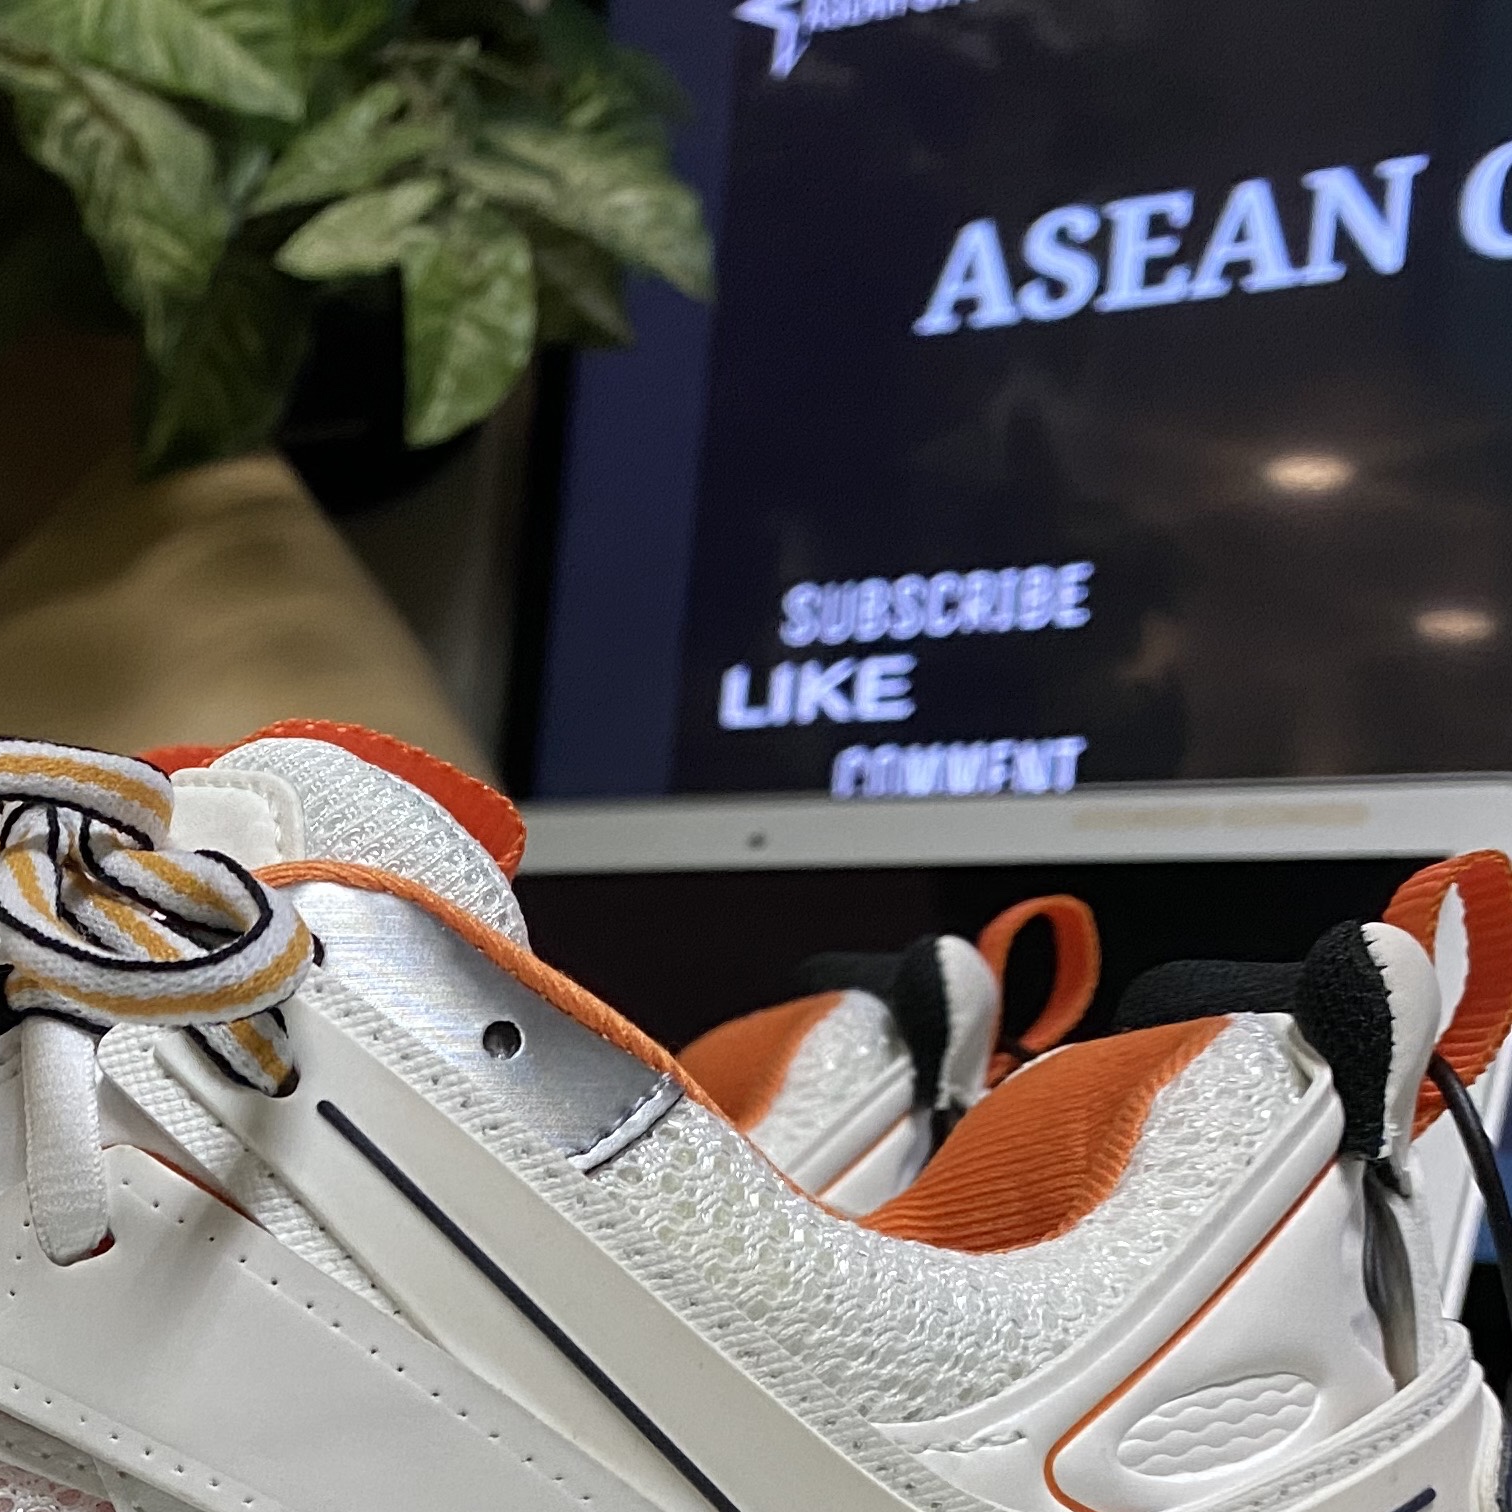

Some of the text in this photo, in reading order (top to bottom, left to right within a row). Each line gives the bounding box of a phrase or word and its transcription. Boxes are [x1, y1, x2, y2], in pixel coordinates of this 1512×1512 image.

[911, 154, 1430, 336] ASEAN
[779, 561, 1095, 648] SUBSCRIBE
[718, 653, 918, 730] LIKE
